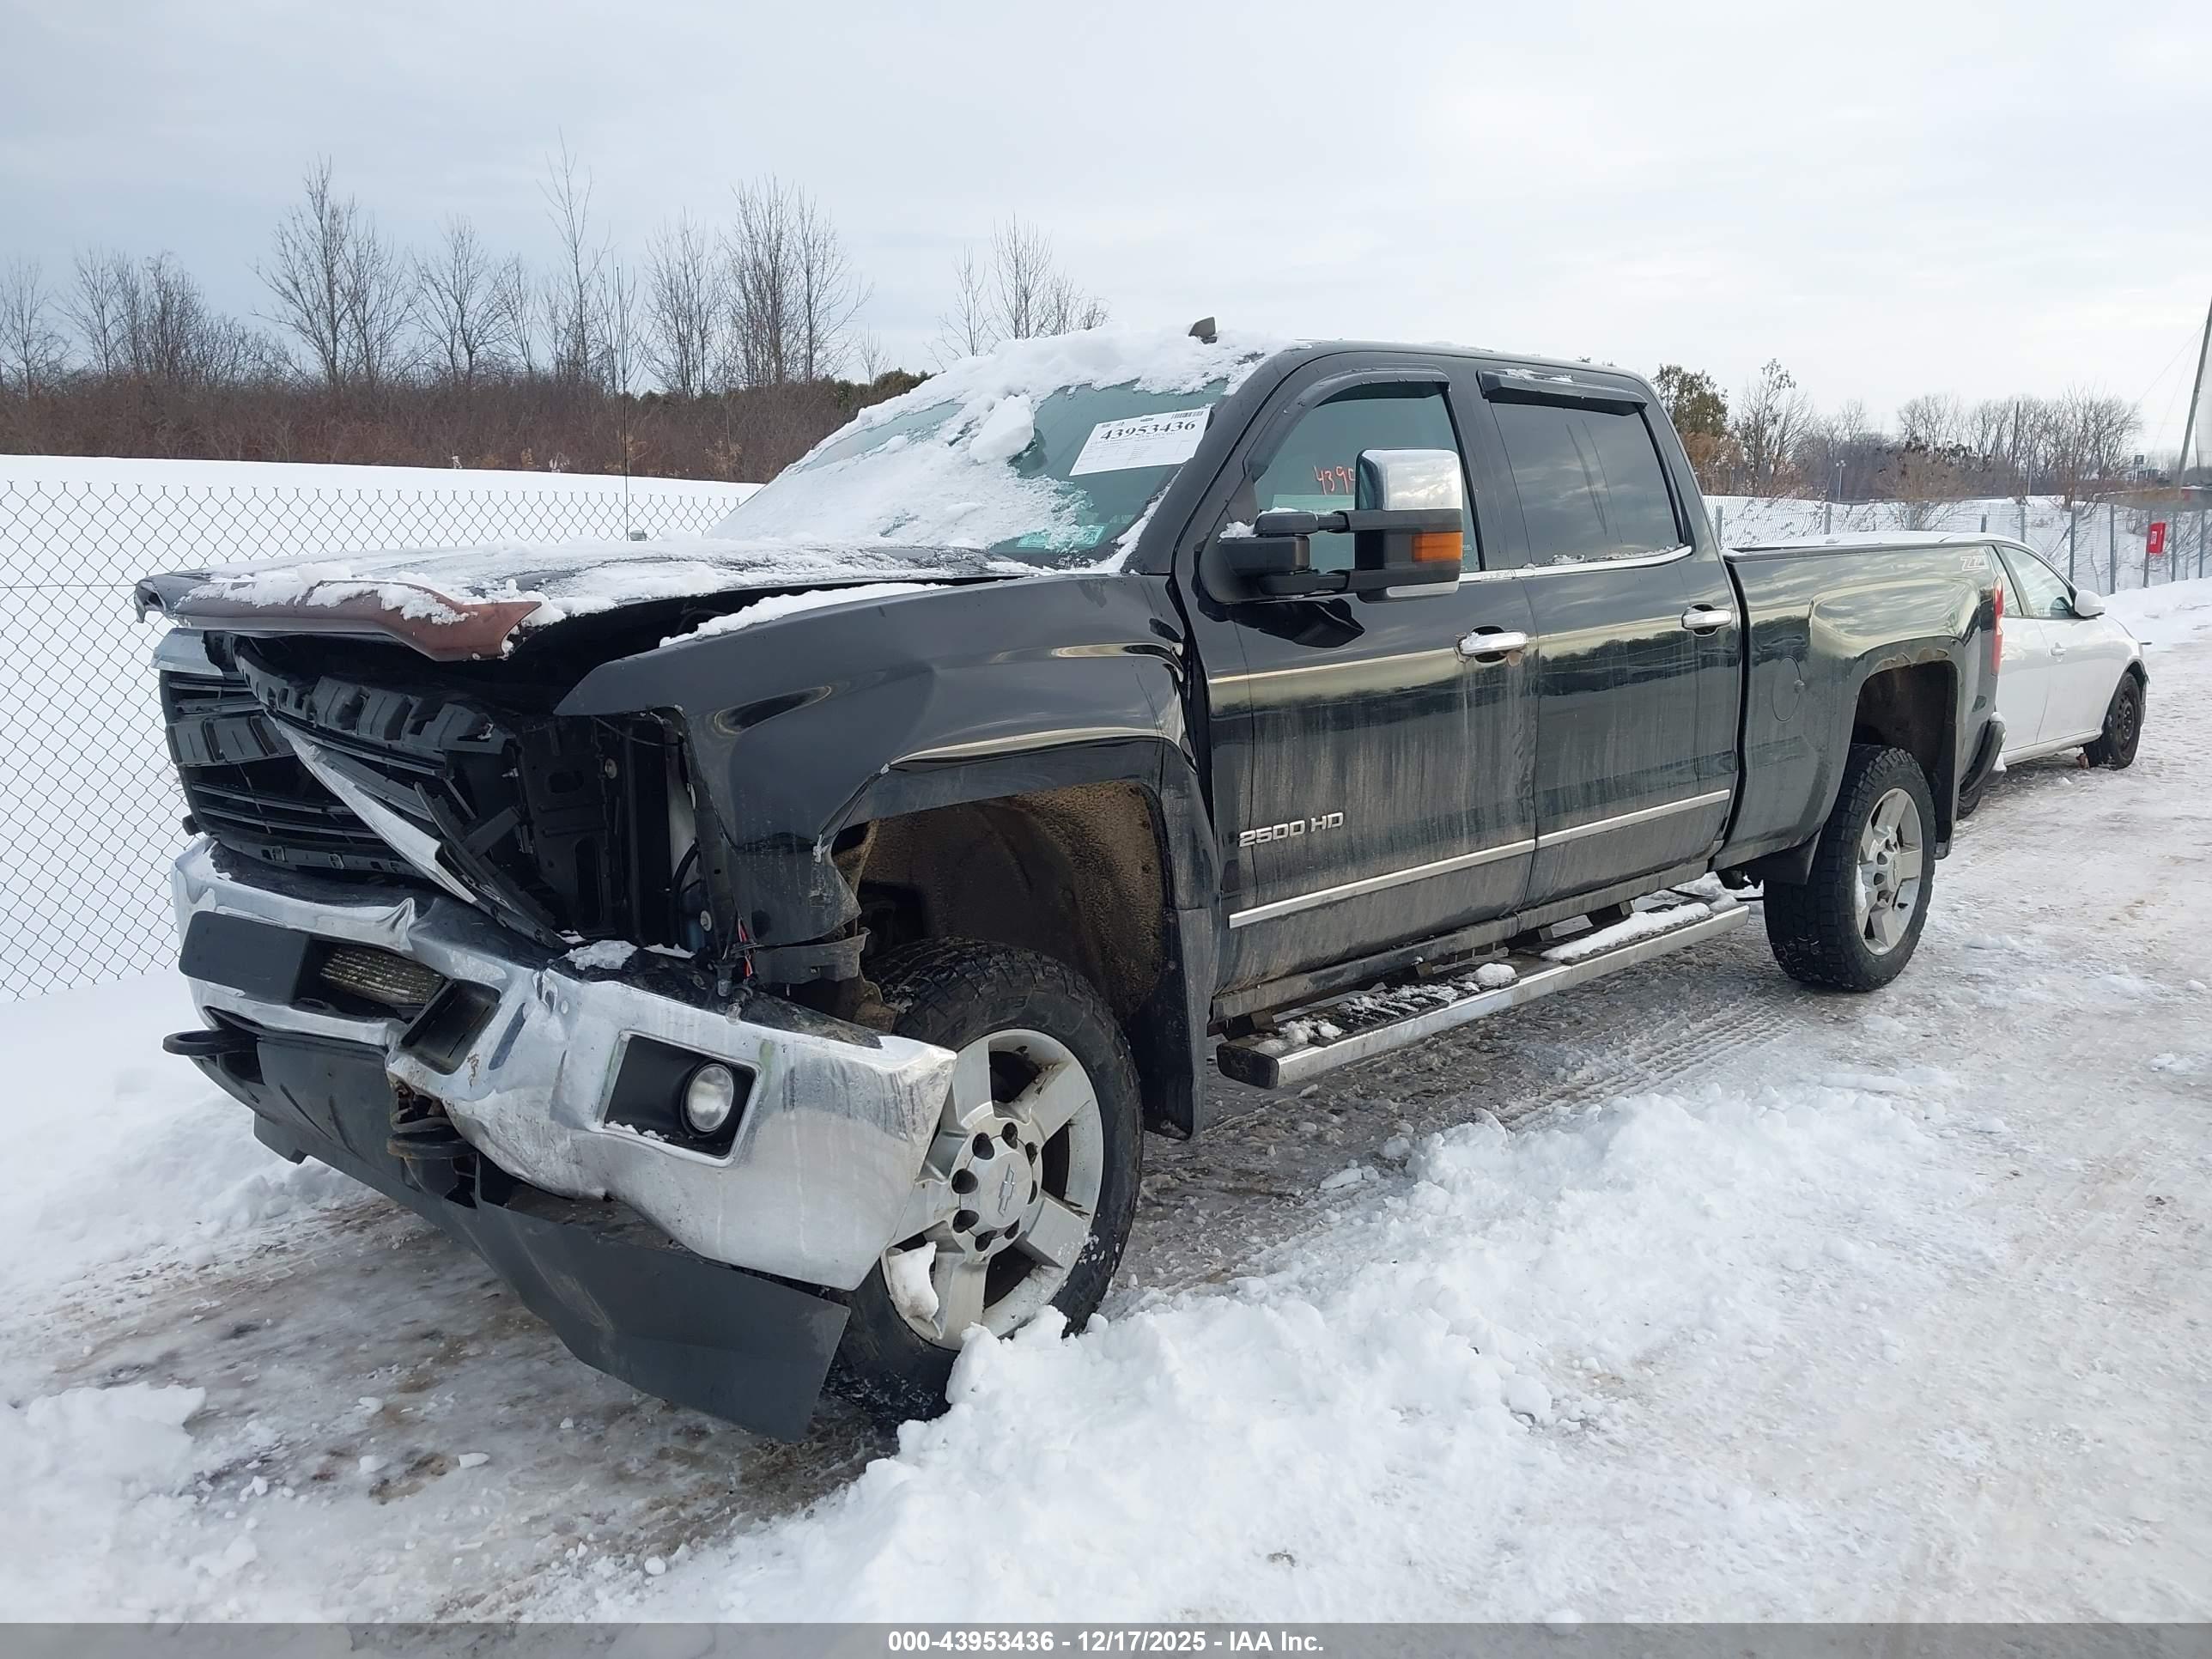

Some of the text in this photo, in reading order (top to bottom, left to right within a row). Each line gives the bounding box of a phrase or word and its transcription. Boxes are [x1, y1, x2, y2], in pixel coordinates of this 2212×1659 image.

[1100, 420, 1196, 441] 43953436
[1238, 811, 1345, 848] 2500 HD
